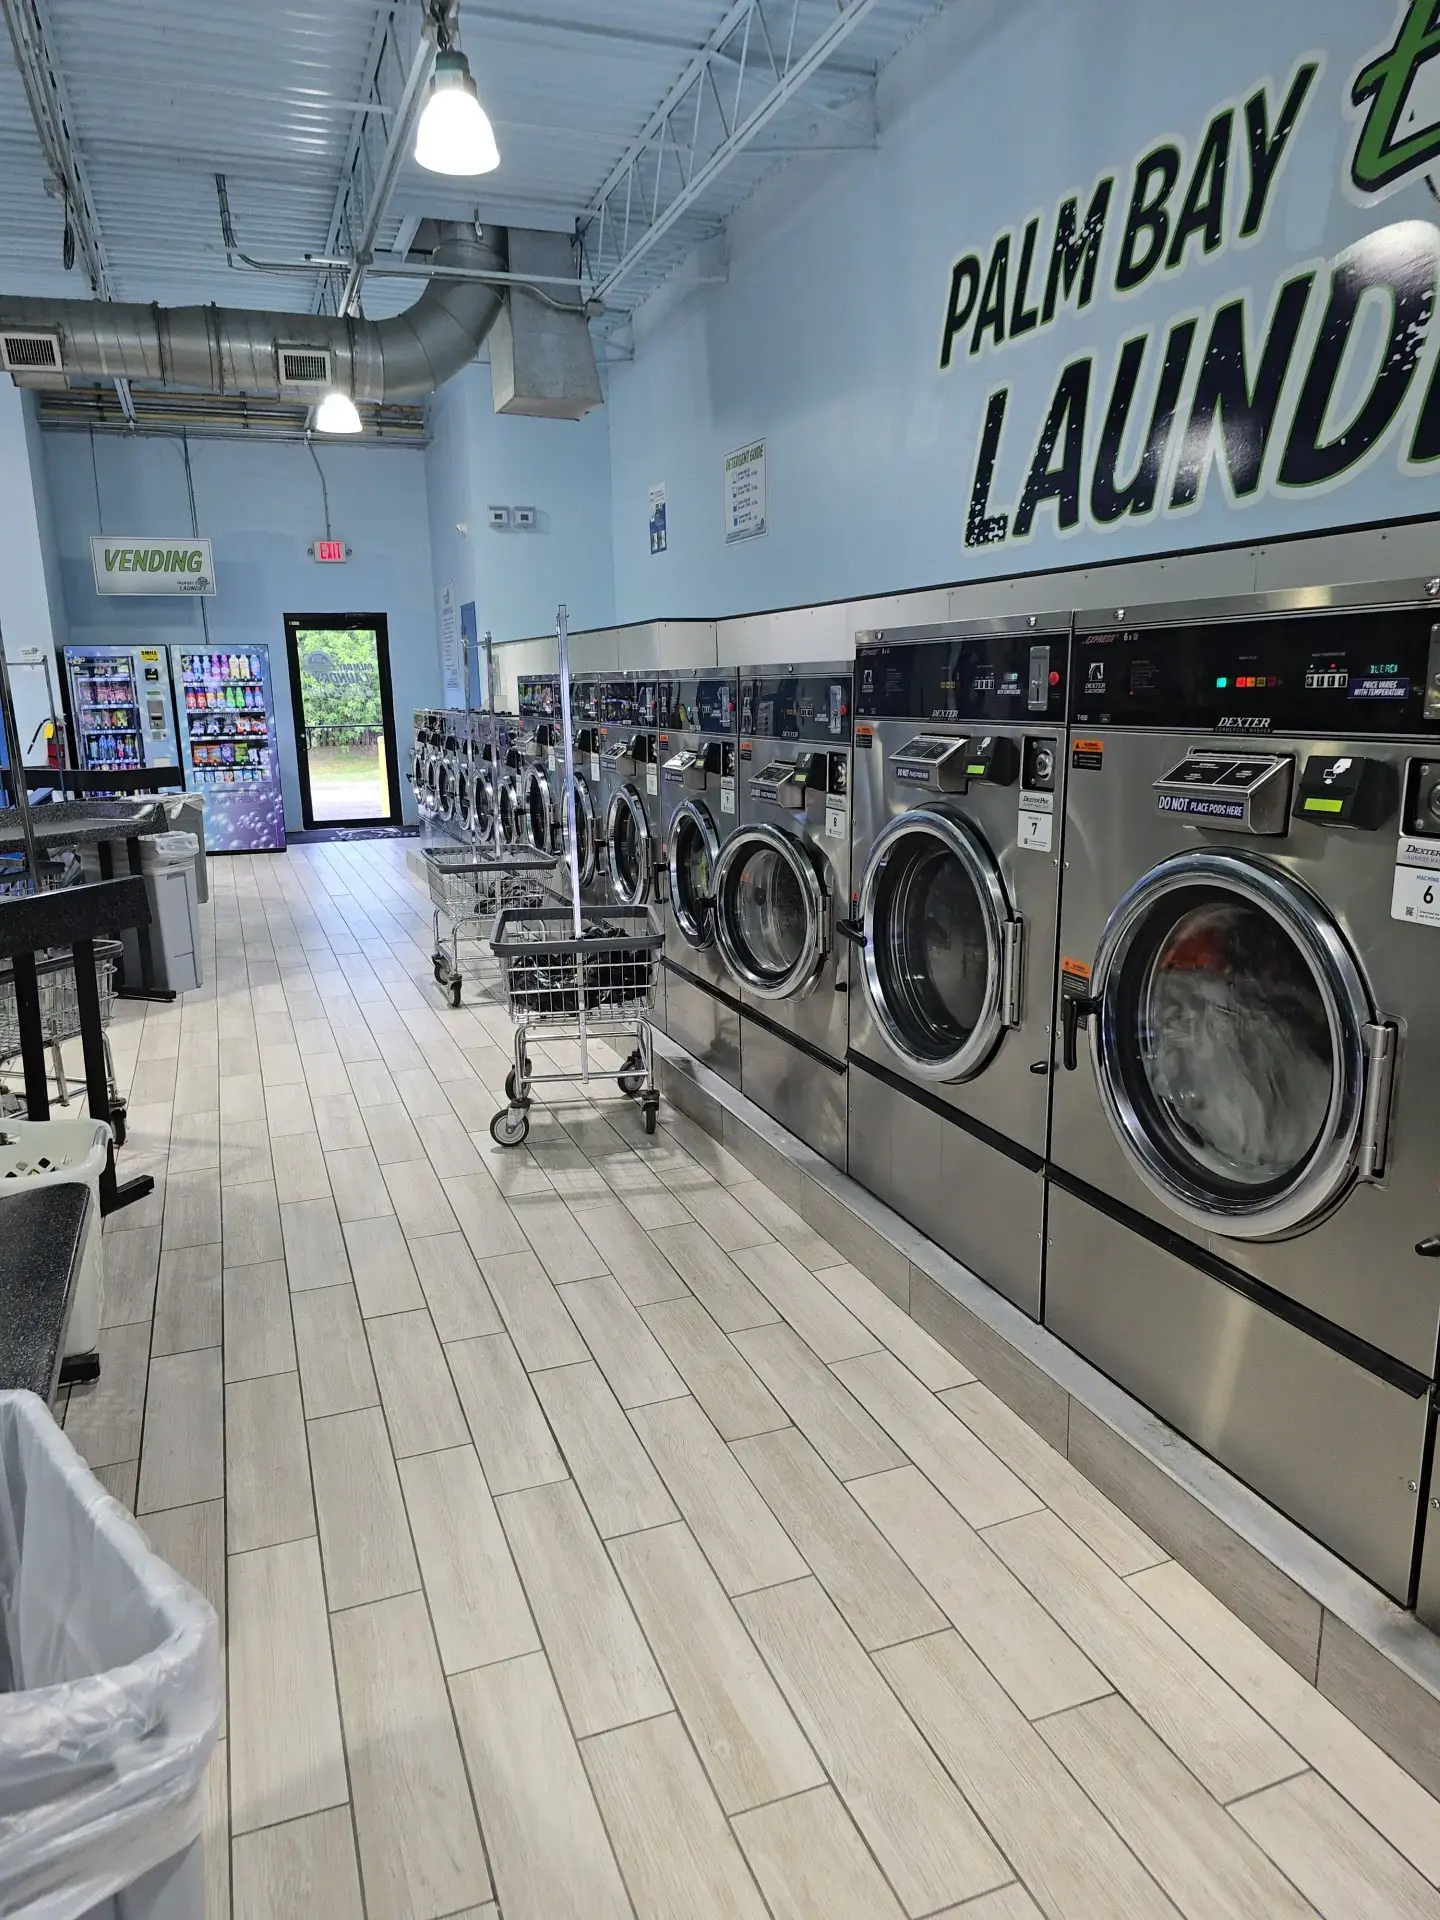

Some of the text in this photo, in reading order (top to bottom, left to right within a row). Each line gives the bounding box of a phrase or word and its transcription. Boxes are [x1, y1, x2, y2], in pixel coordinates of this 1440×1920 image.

[940, 176, 1115, 370] PALM
[1113, 62, 1320, 292] BAY
[725, 450, 750, 472] DETERGENT
[320, 542, 342, 560] EXIT
[104, 549, 203, 573] VENDING
[1354, 687, 1406, 696] WITH TEMPERATURE
[1362, 680, 1379, 689] PRICE
[931, 709, 959, 718] DEXTER
[1217, 717, 1271, 728] DEXTER
[1158, 796, 1244, 817] DO NOT PLACE PODS HERE
[833, 817, 838, 827] 8
[1031, 822, 1038, 836] 7
[1422, 885, 1434, 904] 6
